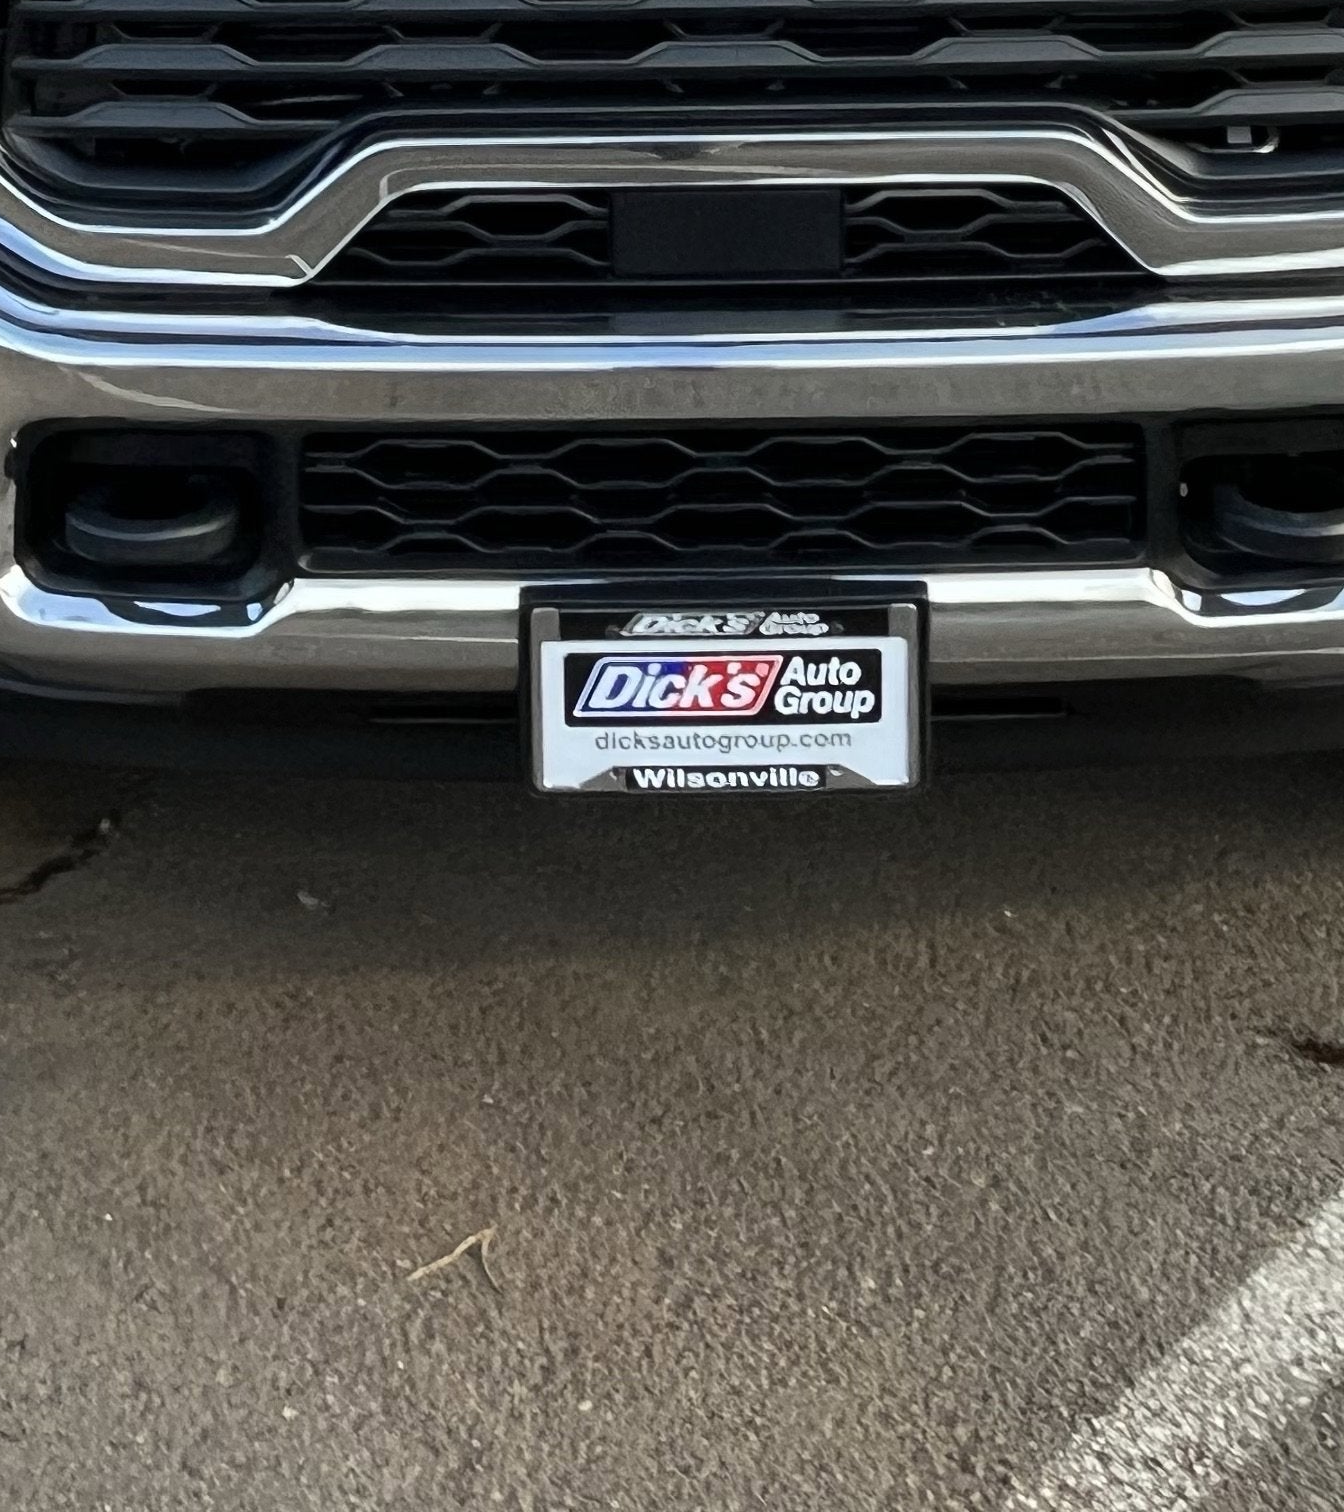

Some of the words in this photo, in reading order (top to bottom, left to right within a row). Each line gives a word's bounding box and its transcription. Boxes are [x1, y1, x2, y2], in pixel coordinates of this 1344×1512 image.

[588, 661, 769, 710] Dick's
[780, 656, 862, 687] Auto
[774, 687, 876, 719] Group
[594, 730, 852, 754] dicksautogroup.com
[632, 766, 821, 789] Wilsonville
